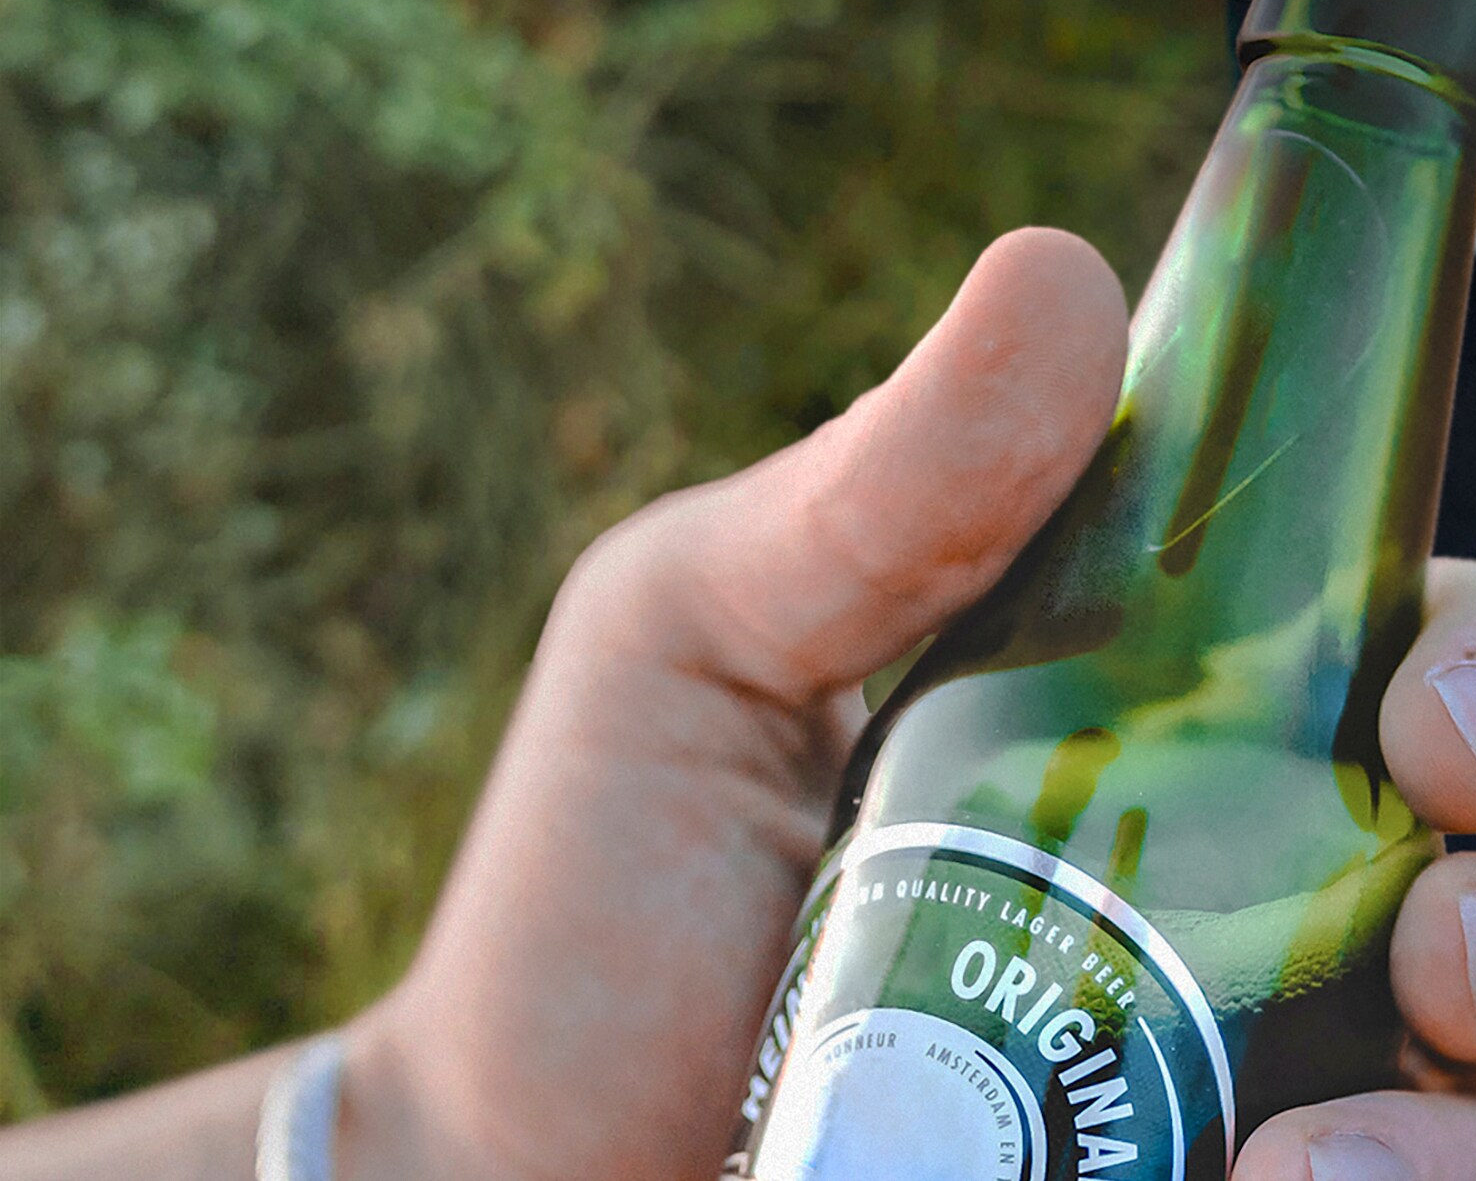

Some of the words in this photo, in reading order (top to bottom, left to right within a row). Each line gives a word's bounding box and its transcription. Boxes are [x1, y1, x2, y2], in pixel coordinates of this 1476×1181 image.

[896, 880, 991, 911] QUALITY
[1000, 901, 1075, 954] LAGER
[1081, 952, 1135, 1010] BEER
[925, 1043, 1012, 1129] AMSTERDAM
[950, 939, 1138, 1181] ORIGINA
